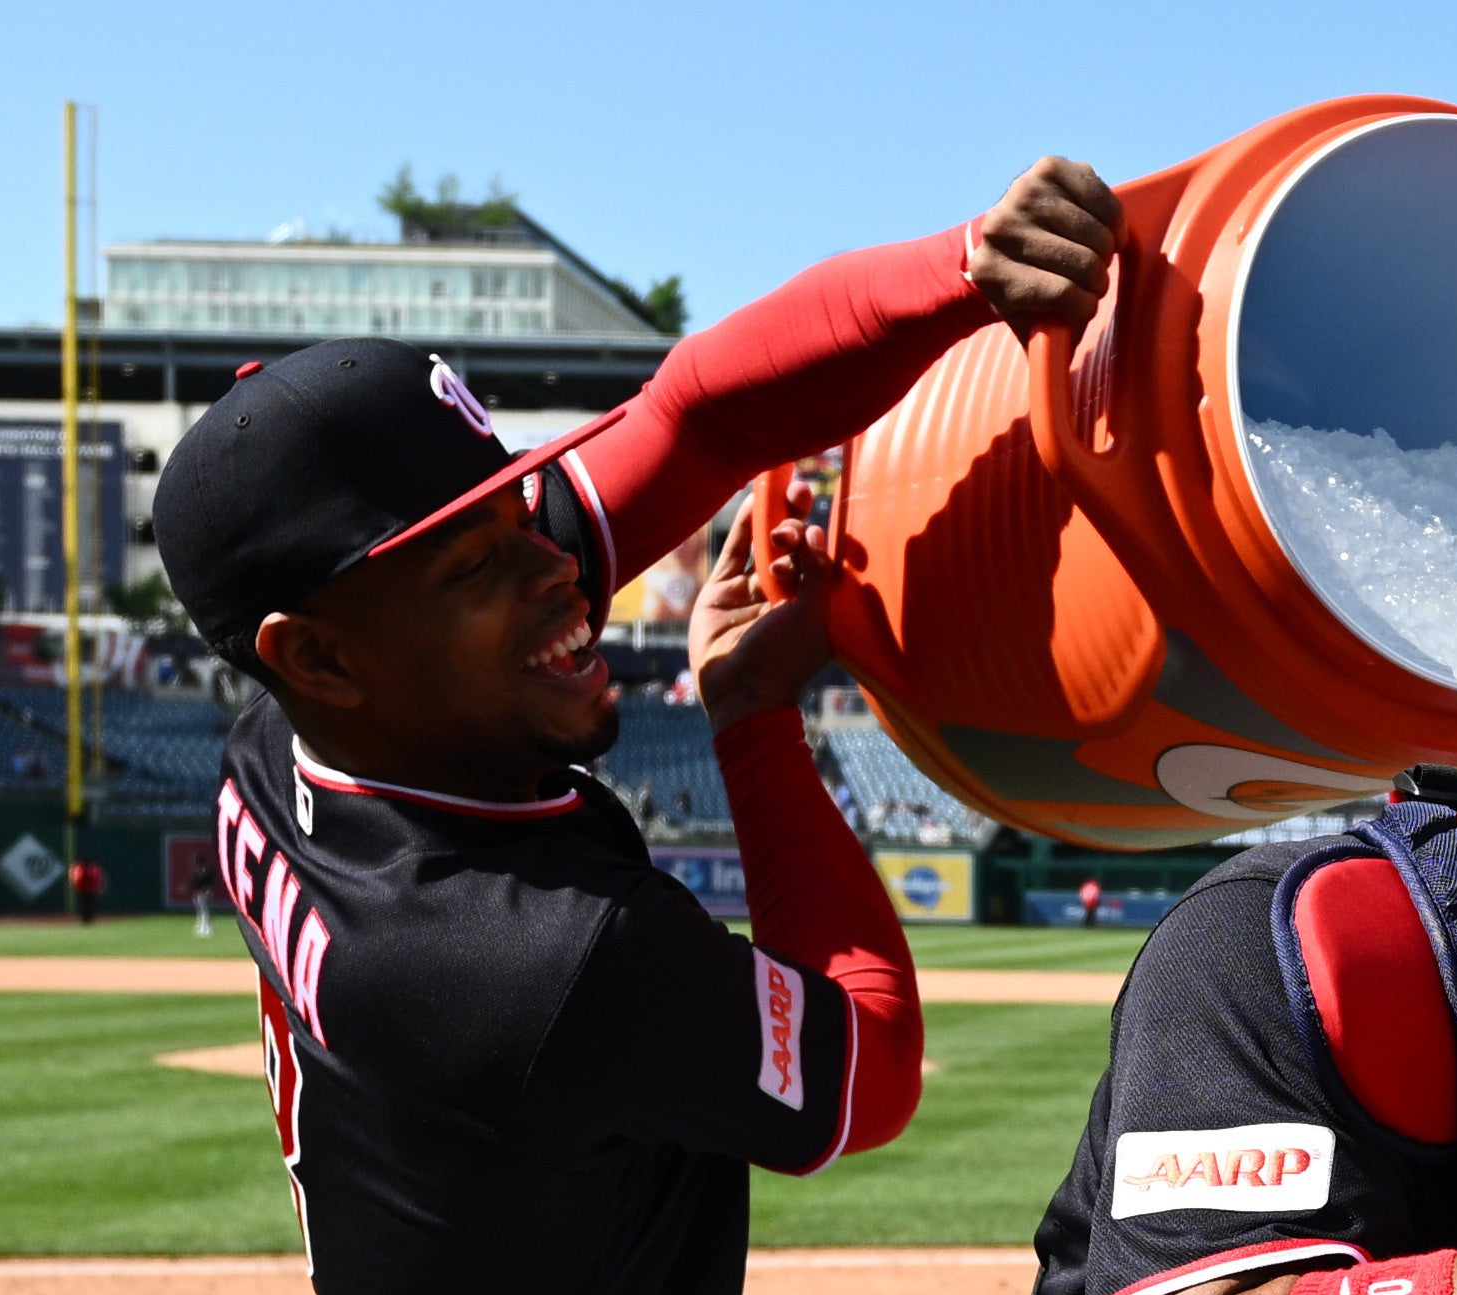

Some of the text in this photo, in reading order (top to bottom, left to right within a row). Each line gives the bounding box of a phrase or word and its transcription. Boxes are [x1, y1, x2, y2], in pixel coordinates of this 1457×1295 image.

[218, 778, 330, 1050] TENA
[769, 964, 792, 1095] AARP
[1123, 1148, 1311, 1191] AARP
